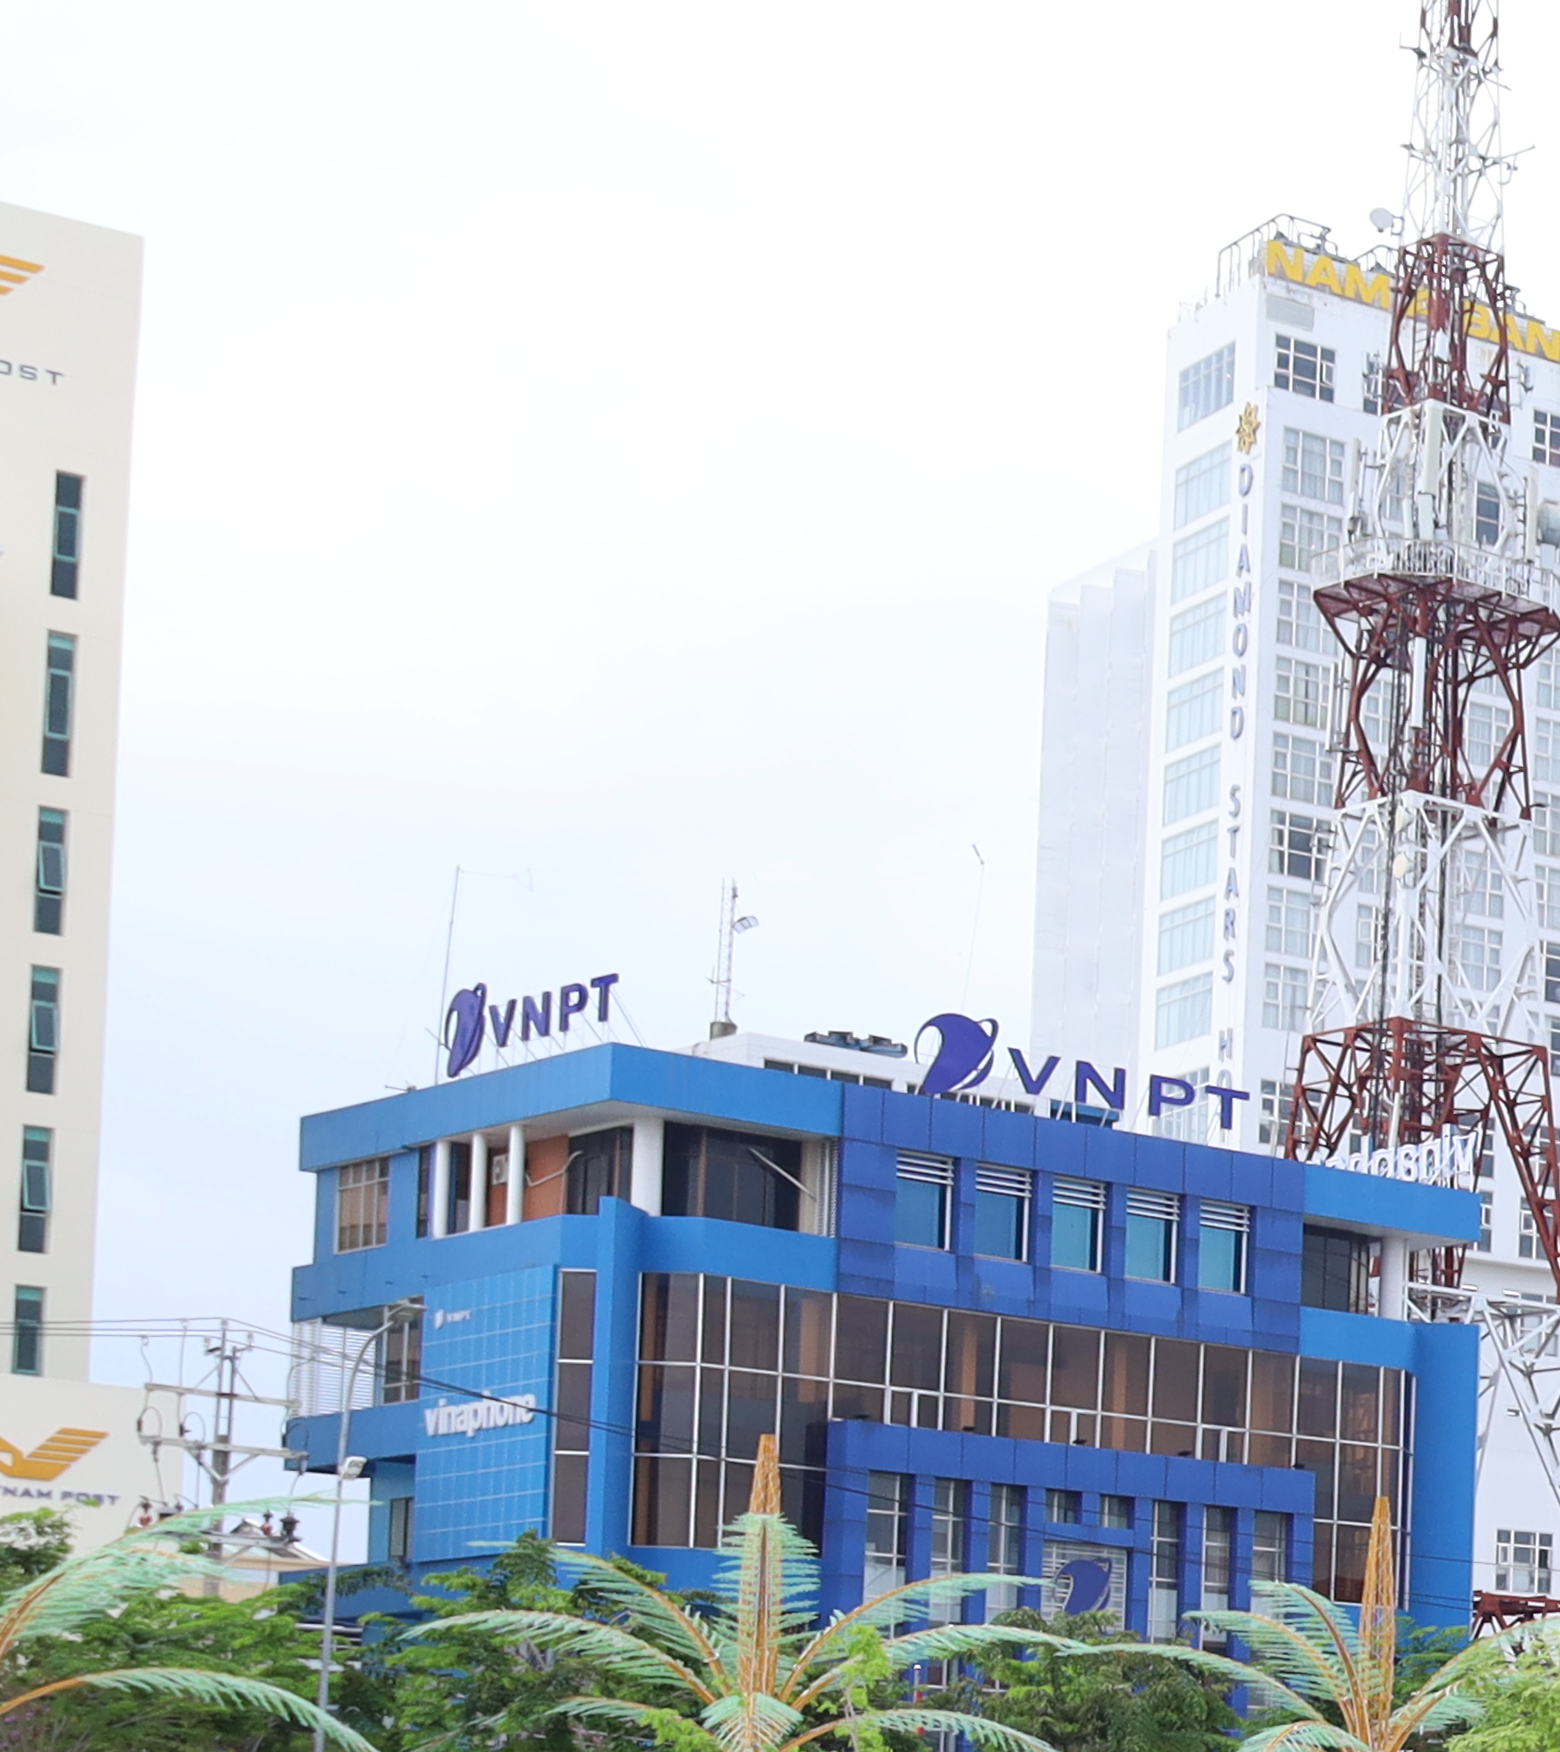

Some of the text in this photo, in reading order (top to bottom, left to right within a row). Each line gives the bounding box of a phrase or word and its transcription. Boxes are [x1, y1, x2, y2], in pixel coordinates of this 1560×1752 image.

[1266, 240, 1391, 309] NAM
[0, 359, 65, 386] OST
[1230, 463, 1253, 740] DIAMOND
[1222, 783, 1241, 984] STARS
[488, 973, 619, 1048] VNPT
[1007, 1047, 1250, 1131] VNPT
[424, 1389, 537, 1438] vinaphone
[0, 1485, 53, 1499] NAM
